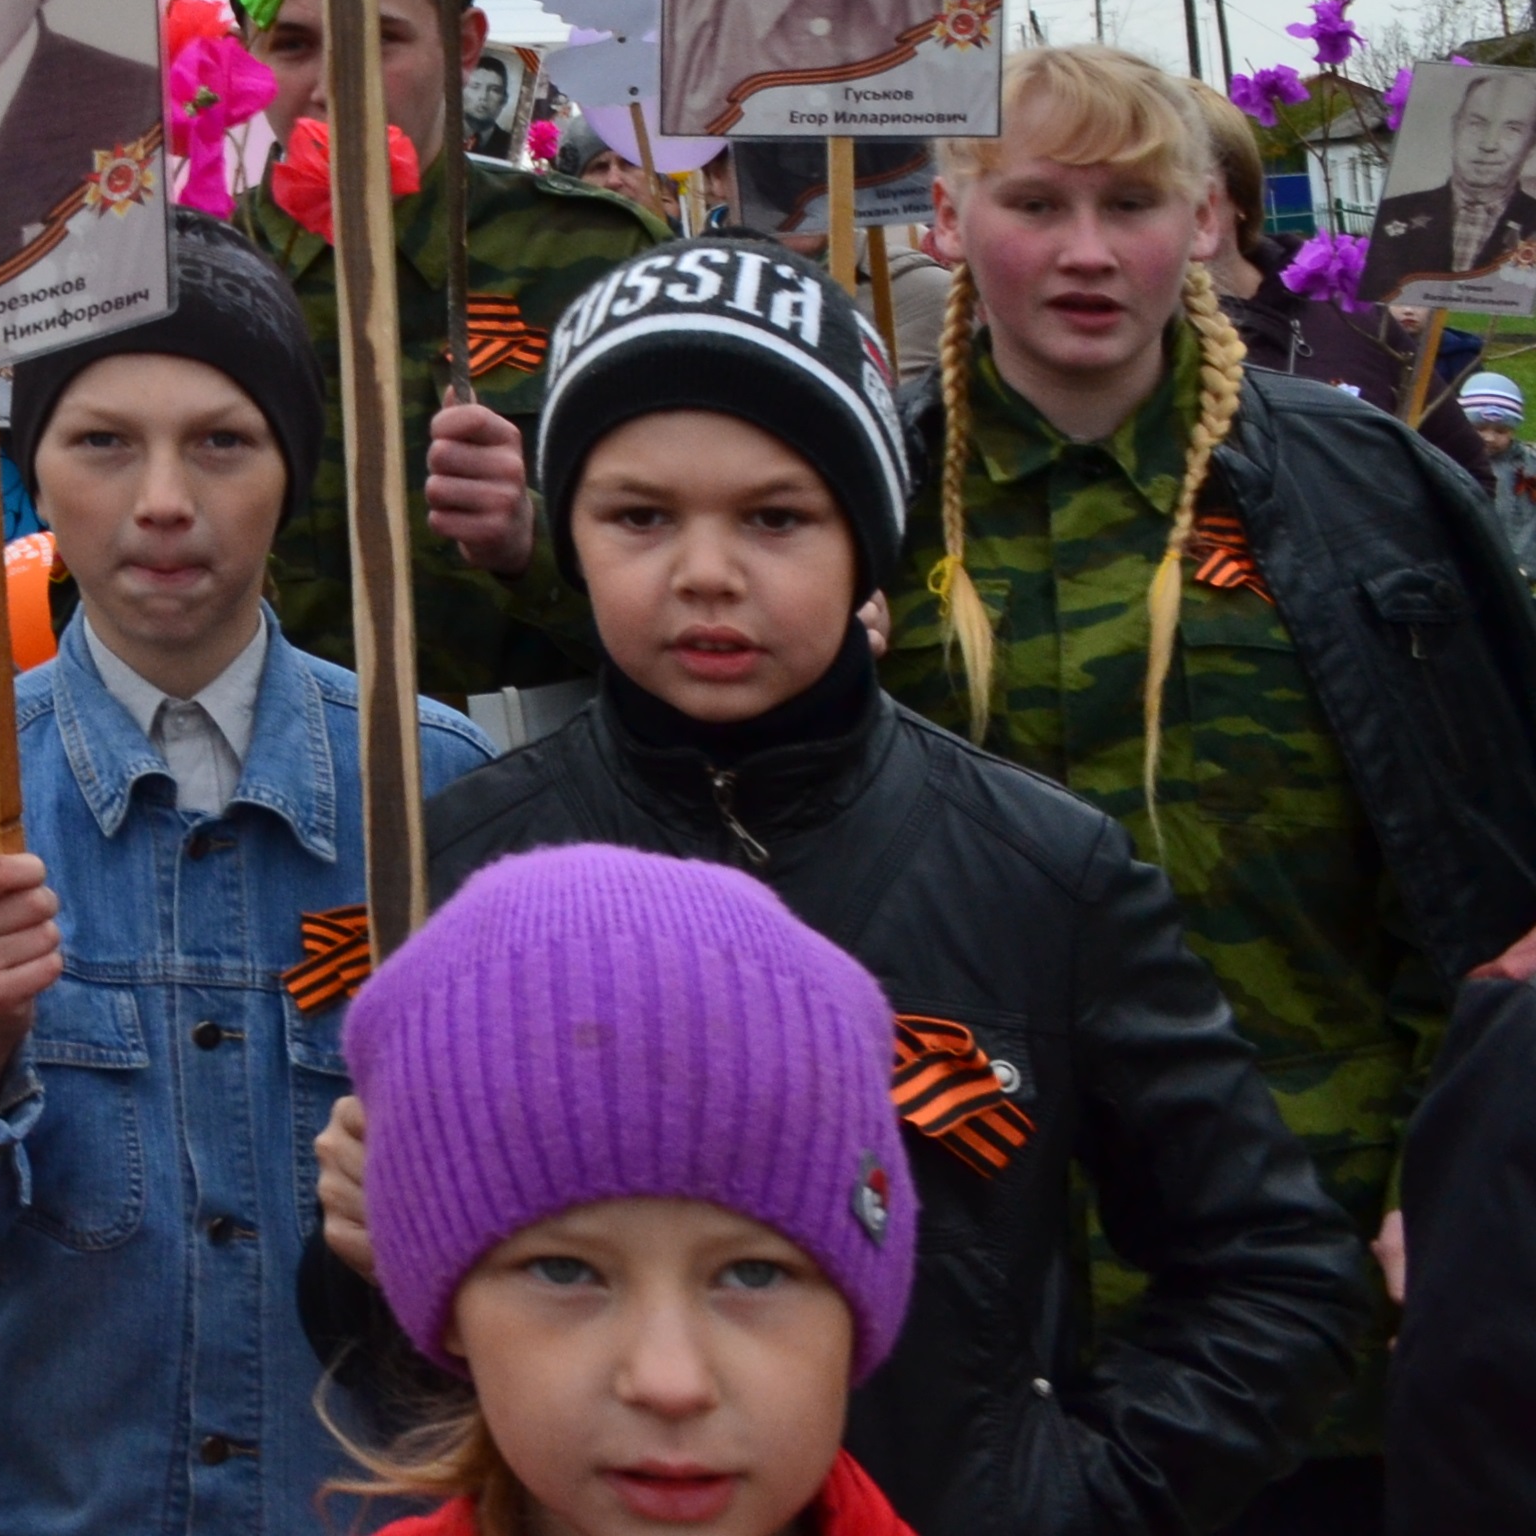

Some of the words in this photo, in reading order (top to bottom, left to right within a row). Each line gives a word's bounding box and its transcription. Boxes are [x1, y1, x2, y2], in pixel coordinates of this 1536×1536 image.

[844, 87, 914, 103] Гуськов
[789, 111, 829, 127] Егор
[834, 110, 967, 126] Илларионович
[3, 289, 150, 343] Никифорович
